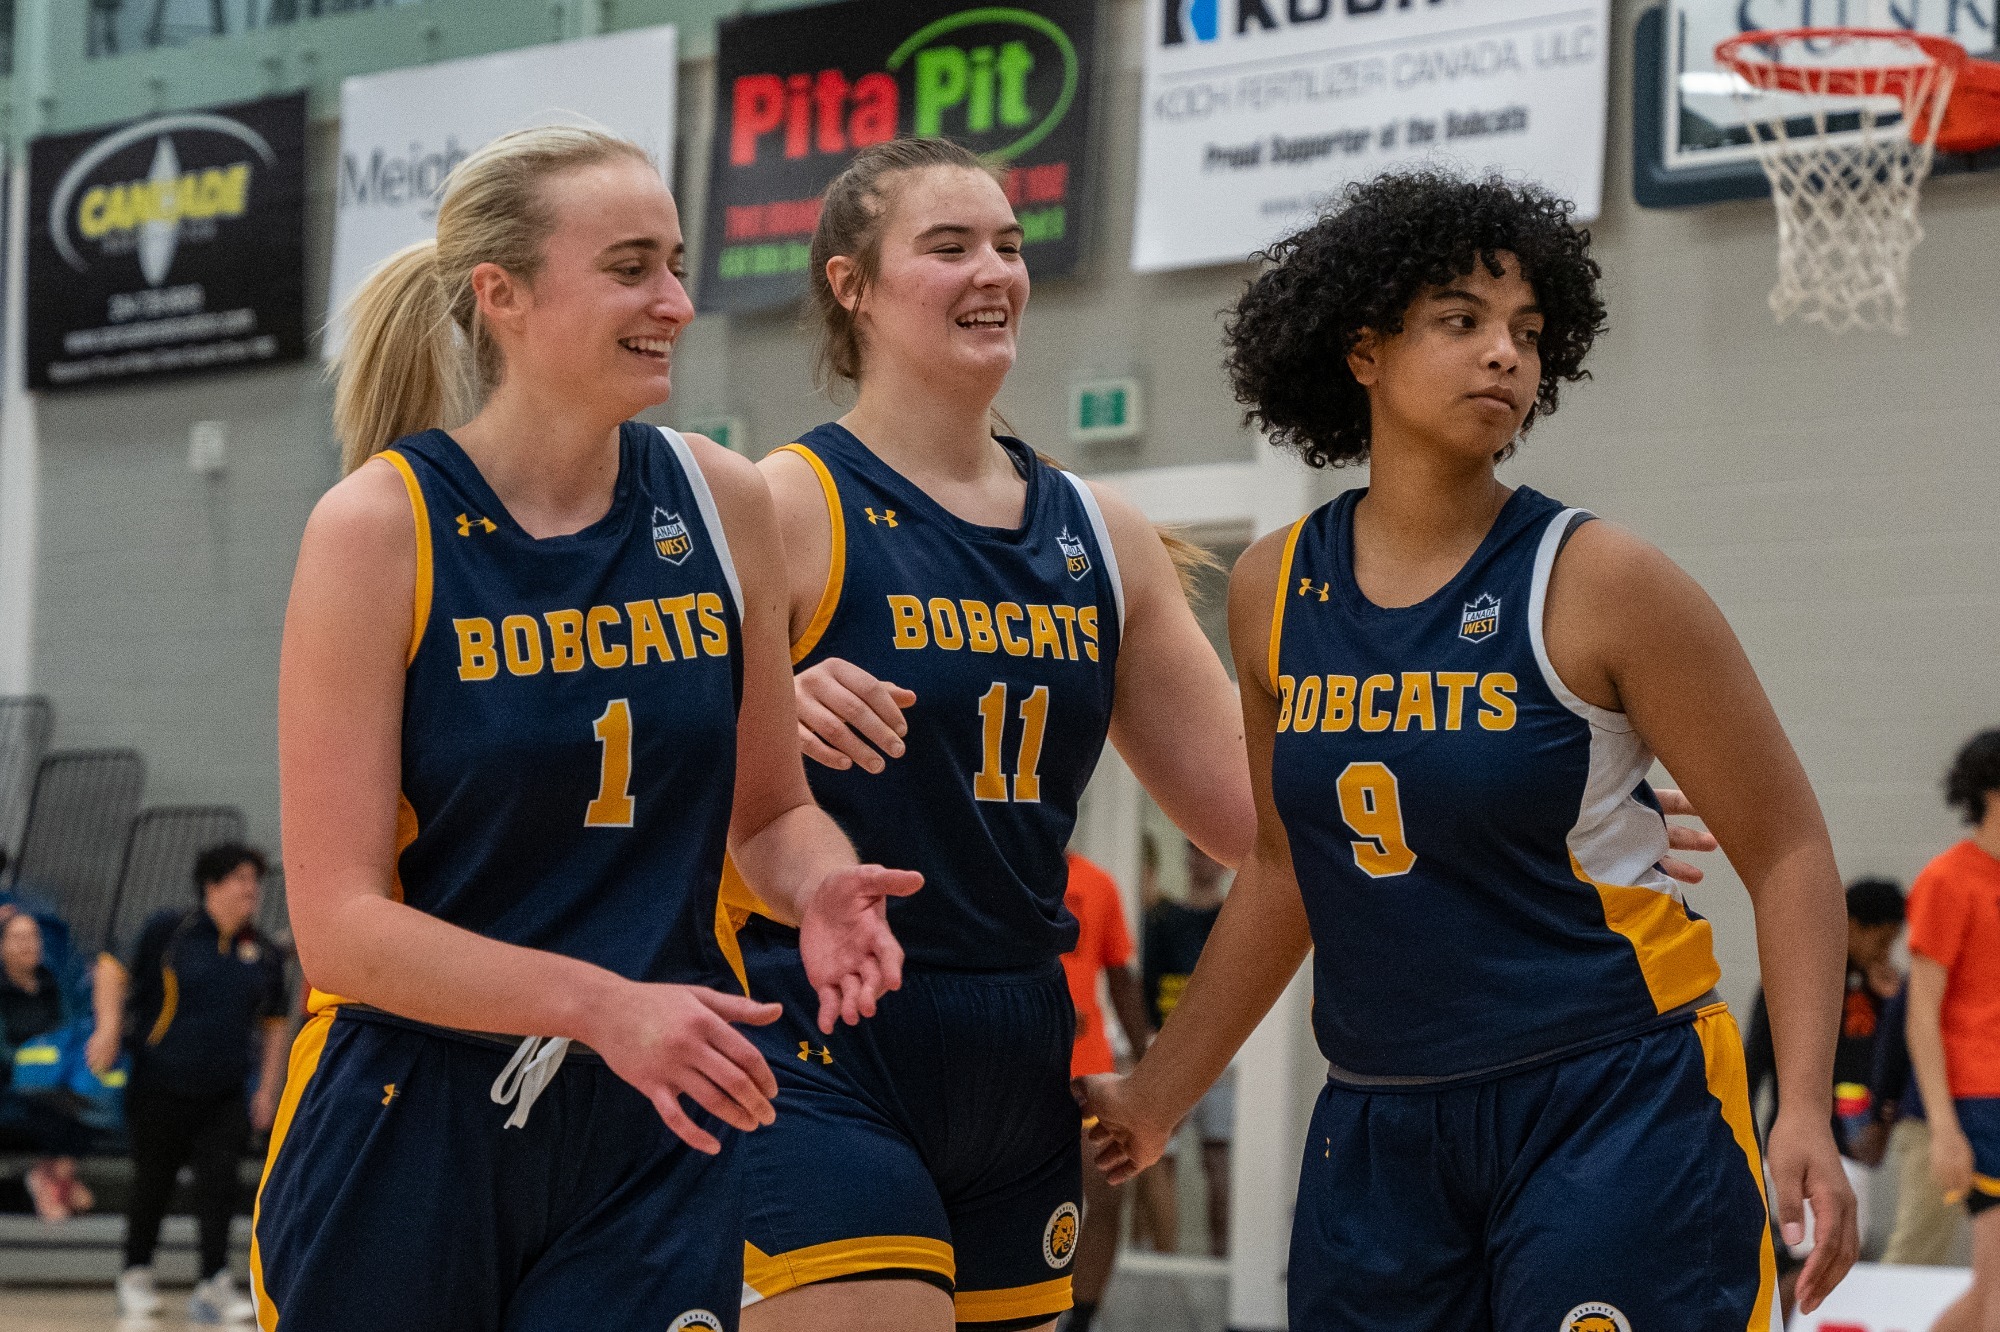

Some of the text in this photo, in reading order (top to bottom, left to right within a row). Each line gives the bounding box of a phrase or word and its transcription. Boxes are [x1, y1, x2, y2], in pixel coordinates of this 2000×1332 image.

[730, 40, 1034, 166] Pita Pit
[657, 535, 689, 556] WEST
[452, 592, 728, 681] BOBCATS
[886, 595, 1099, 662] BOBCATS
[1463, 618, 1495, 635] WEST
[1465, 607, 1496, 622] CANADA
[1277, 671, 1517, 732] BOBCATS
[584, 698, 635, 827] 1
[974, 682, 1049, 803] 11
[1336, 761, 1417, 878] 9
